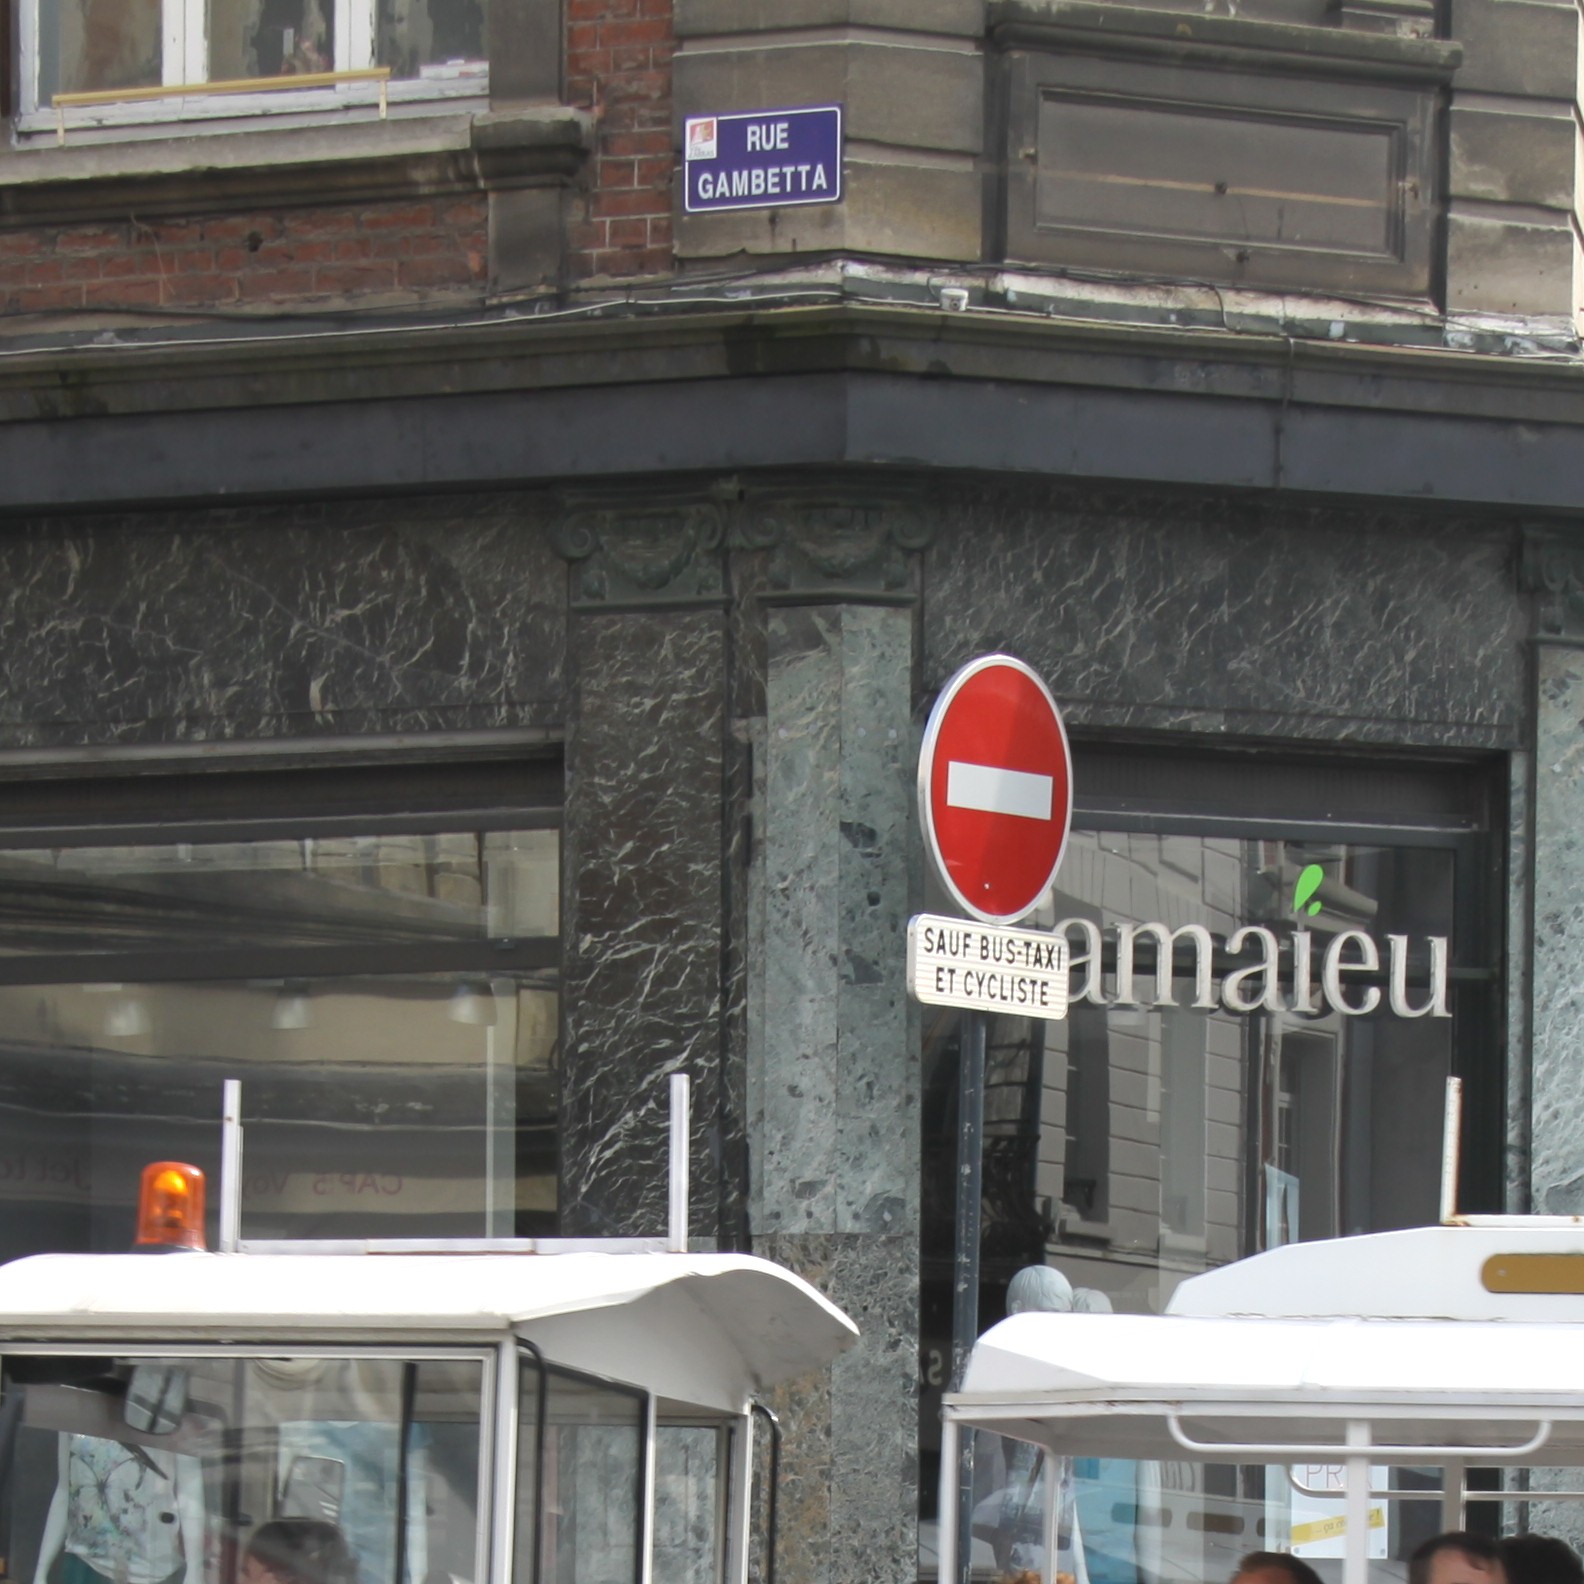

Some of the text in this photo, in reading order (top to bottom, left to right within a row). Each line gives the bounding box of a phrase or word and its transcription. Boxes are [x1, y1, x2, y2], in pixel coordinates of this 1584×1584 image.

[746, 122, 789, 152] RUE
[697, 163, 828, 200] GAMBETTA
[924, 927, 1062, 972] SAUF BUS-TAXI
[935, 966, 1049, 1007] ET CYCLISTE
